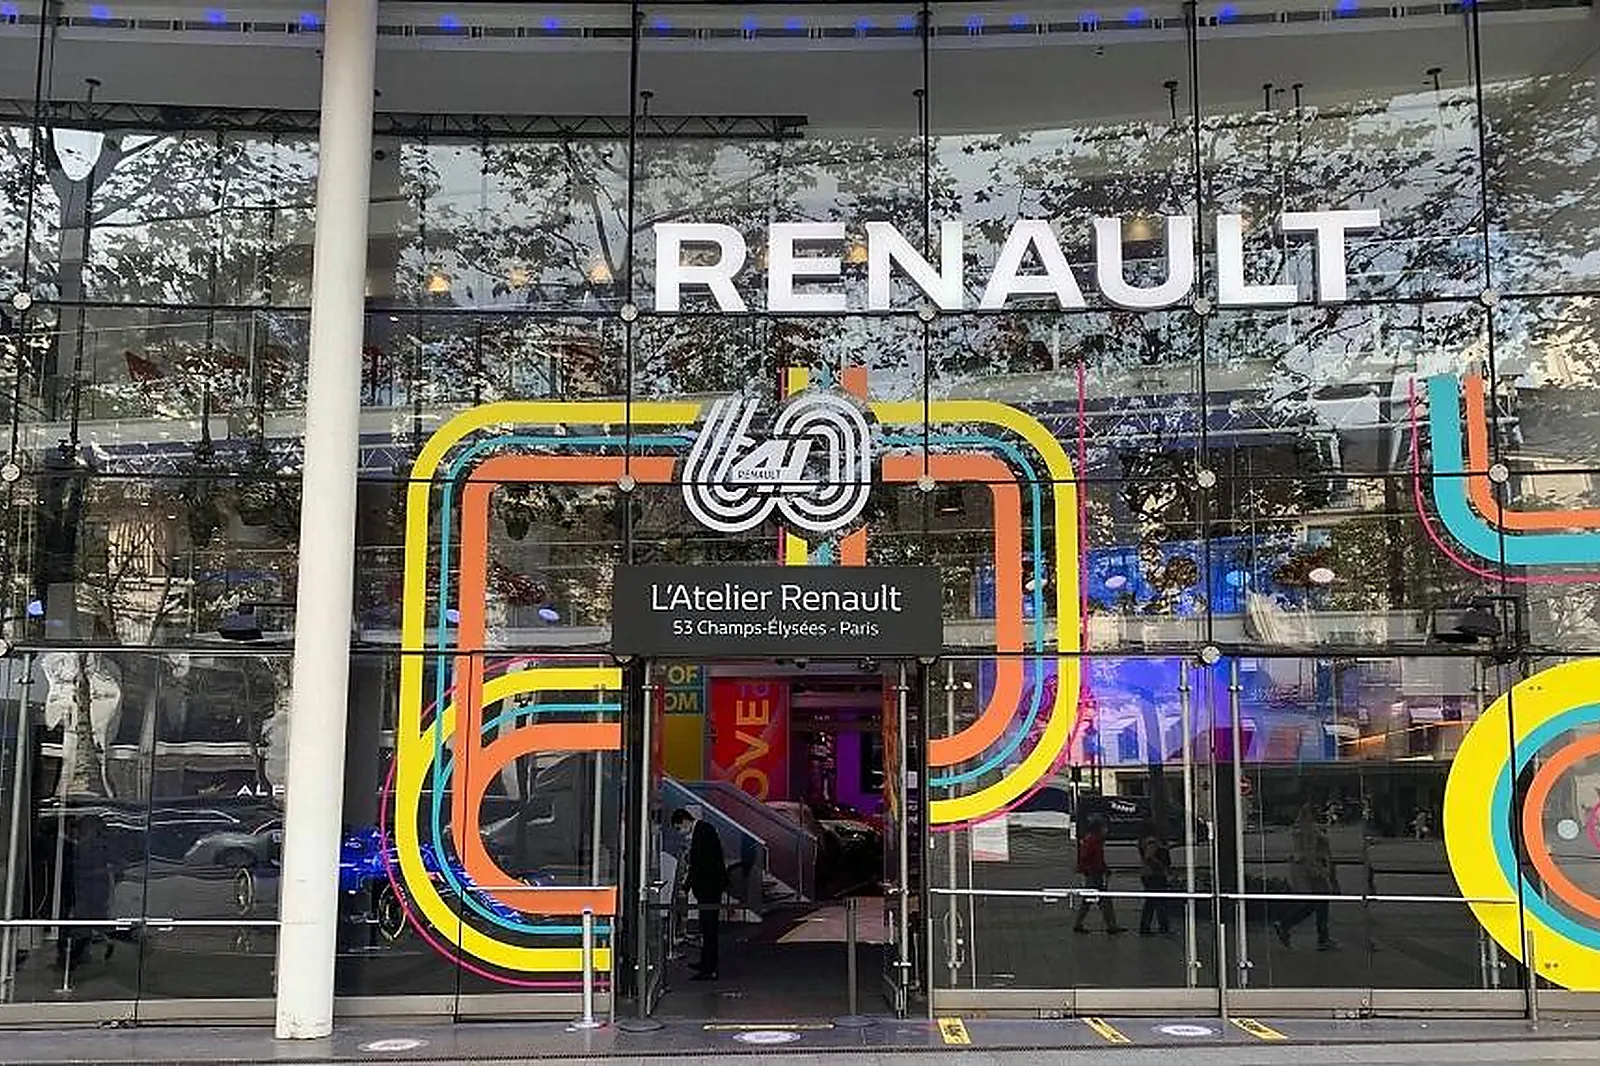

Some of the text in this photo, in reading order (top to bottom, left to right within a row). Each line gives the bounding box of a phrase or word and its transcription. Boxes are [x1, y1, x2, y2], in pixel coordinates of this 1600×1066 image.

[653, 208, 1382, 314] RENAULT
[737, 469, 781, 480] RENAULT
[651, 583, 903, 612] L'Atelier Renault
[673, 620, 693, 636] 53
[697, 616, 827, 639] Champs-Élysées
[840, 620, 879, 636] Paris
